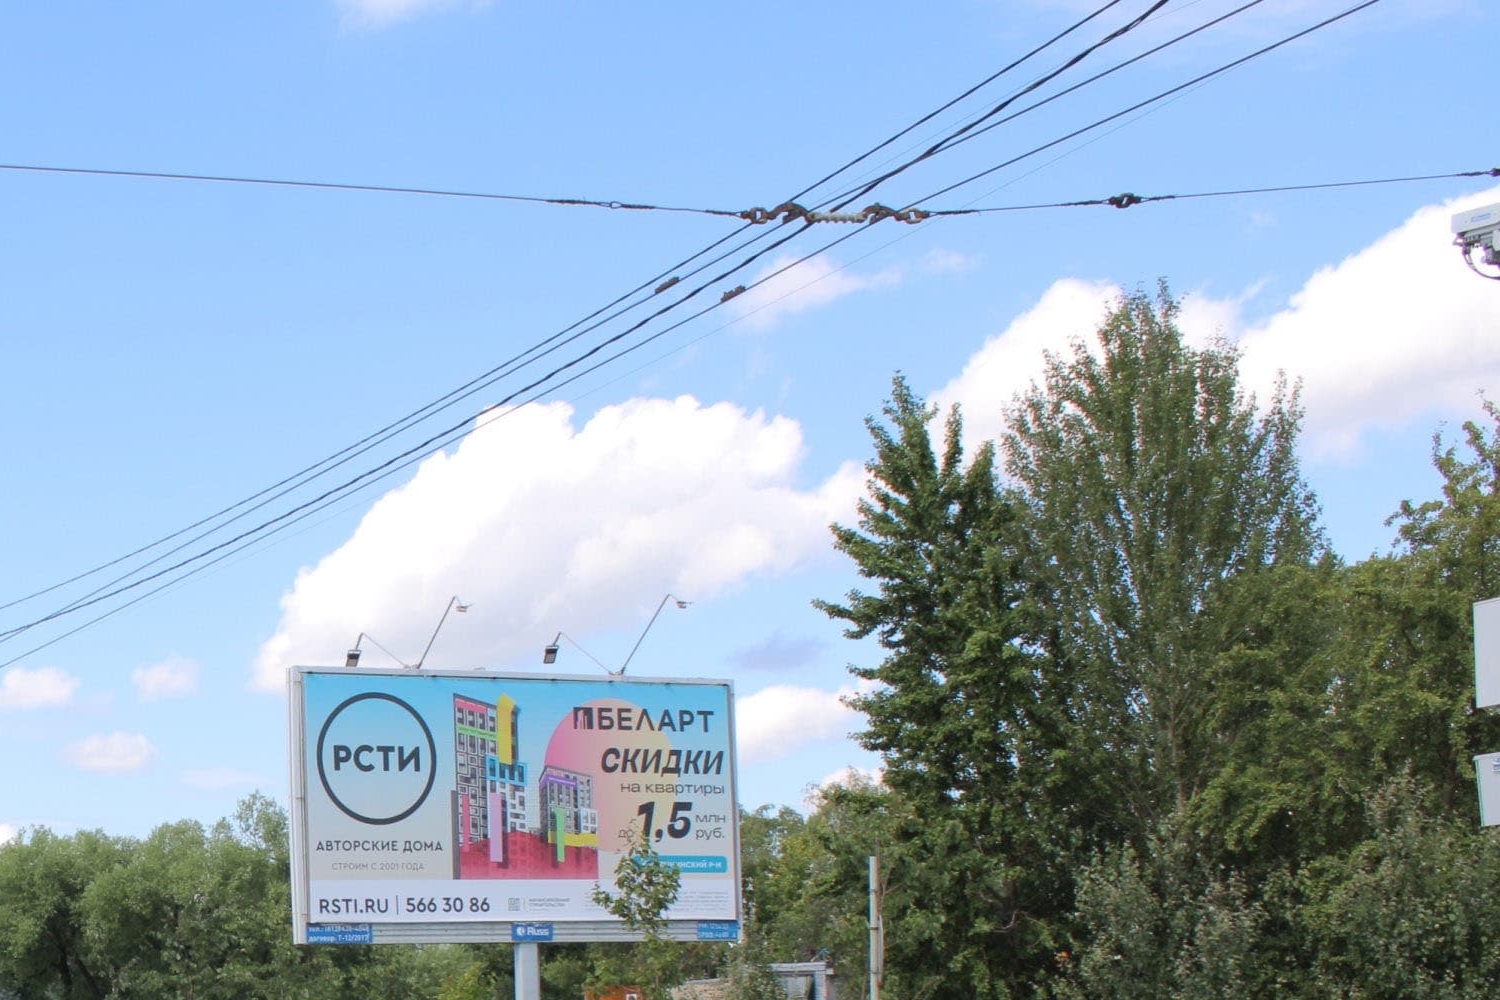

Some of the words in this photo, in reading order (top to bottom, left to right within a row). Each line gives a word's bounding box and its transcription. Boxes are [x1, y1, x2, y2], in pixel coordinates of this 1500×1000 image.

[597, 706, 714, 733] БЕЛАРТ
[333, 744, 421, 773] РСТИ
[601, 748, 724, 778] СКИДКИ
[620, 783, 641, 793] на
[645, 784, 725, 796] квартиры
[637, 801, 693, 843] 1,5
[695, 815, 726, 823] млн
[695, 828, 725, 841] руб.
[316, 840, 398, 851] АВТОРСКИЕ
[403, 841, 443, 853] ДОМА
[332, 862, 368, 871] СТРОИМ
[380, 862, 399, 870] 2001
[402, 863, 425, 872] ГОДА
[319, 898, 389, 914] RSTI.RU
[406, 897, 437, 913] 566
[442, 897, 464, 912] 30
[469, 897, 490, 912] 86
[527, 927, 549, 936] Russ
